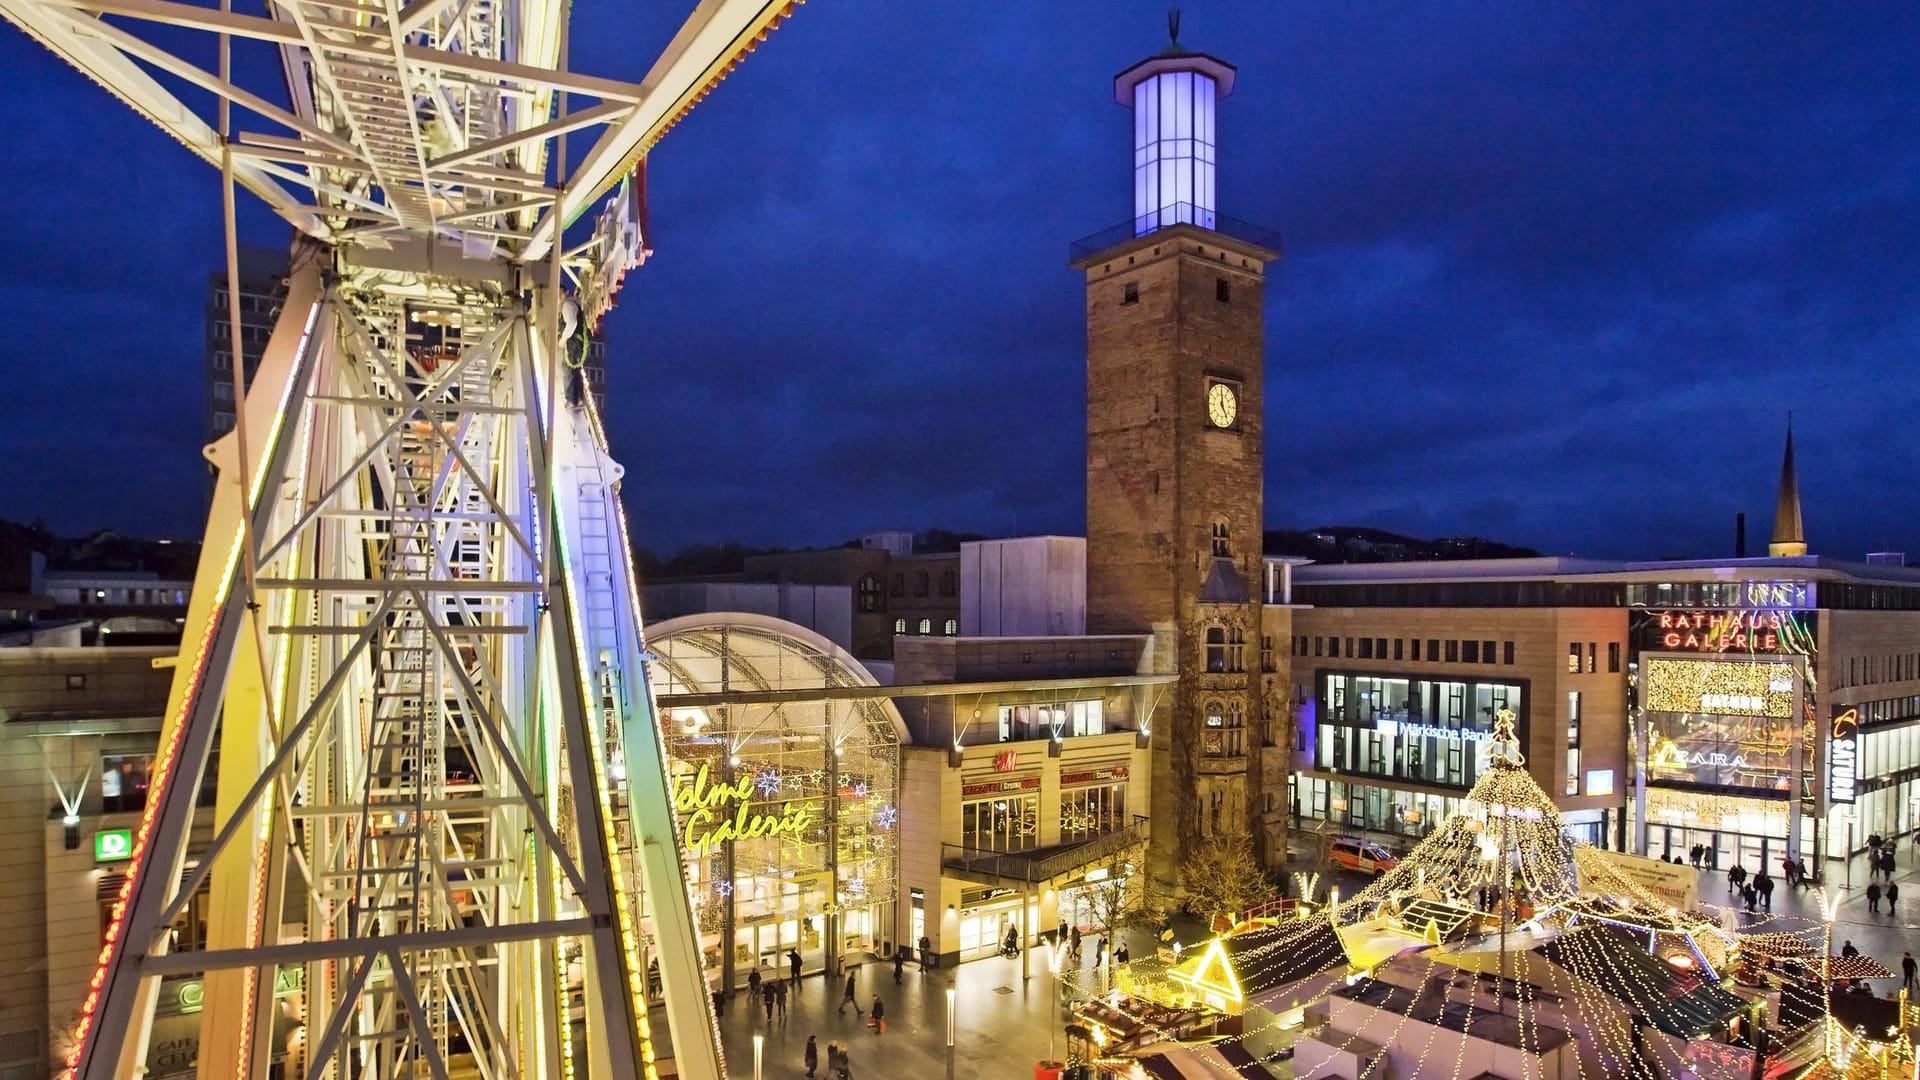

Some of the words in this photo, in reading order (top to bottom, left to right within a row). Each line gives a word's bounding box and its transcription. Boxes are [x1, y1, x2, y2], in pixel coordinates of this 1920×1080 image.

[1661, 614, 1781, 629] RATHAUS
[1664, 633, 1777, 649] GALERIE
[1400, 722, 1459, 738] Märkische
[1676, 750, 1751, 768] ZARA
[1831, 739, 1856, 801] SATURN
[685, 800, 811, 858] Galerie
